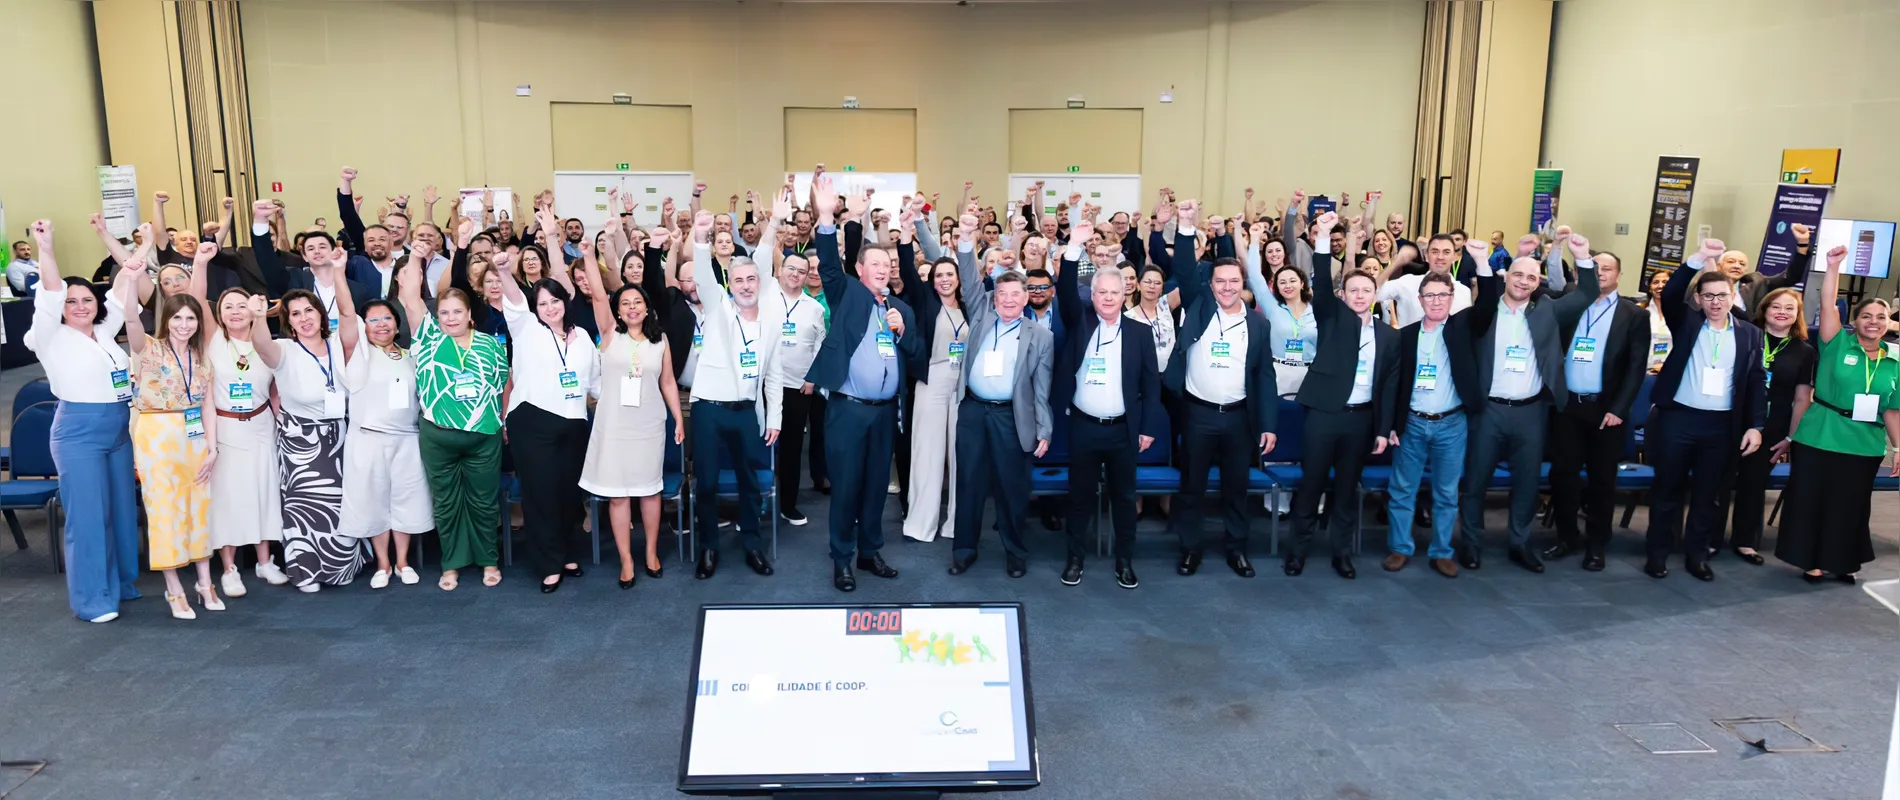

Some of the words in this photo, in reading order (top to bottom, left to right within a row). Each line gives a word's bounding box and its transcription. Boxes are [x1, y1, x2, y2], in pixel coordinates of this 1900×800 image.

[849, 611, 900, 631] 00:00
[731, 682, 822, 692] COILIDADE
[835, 681, 868, 691] COOP.
